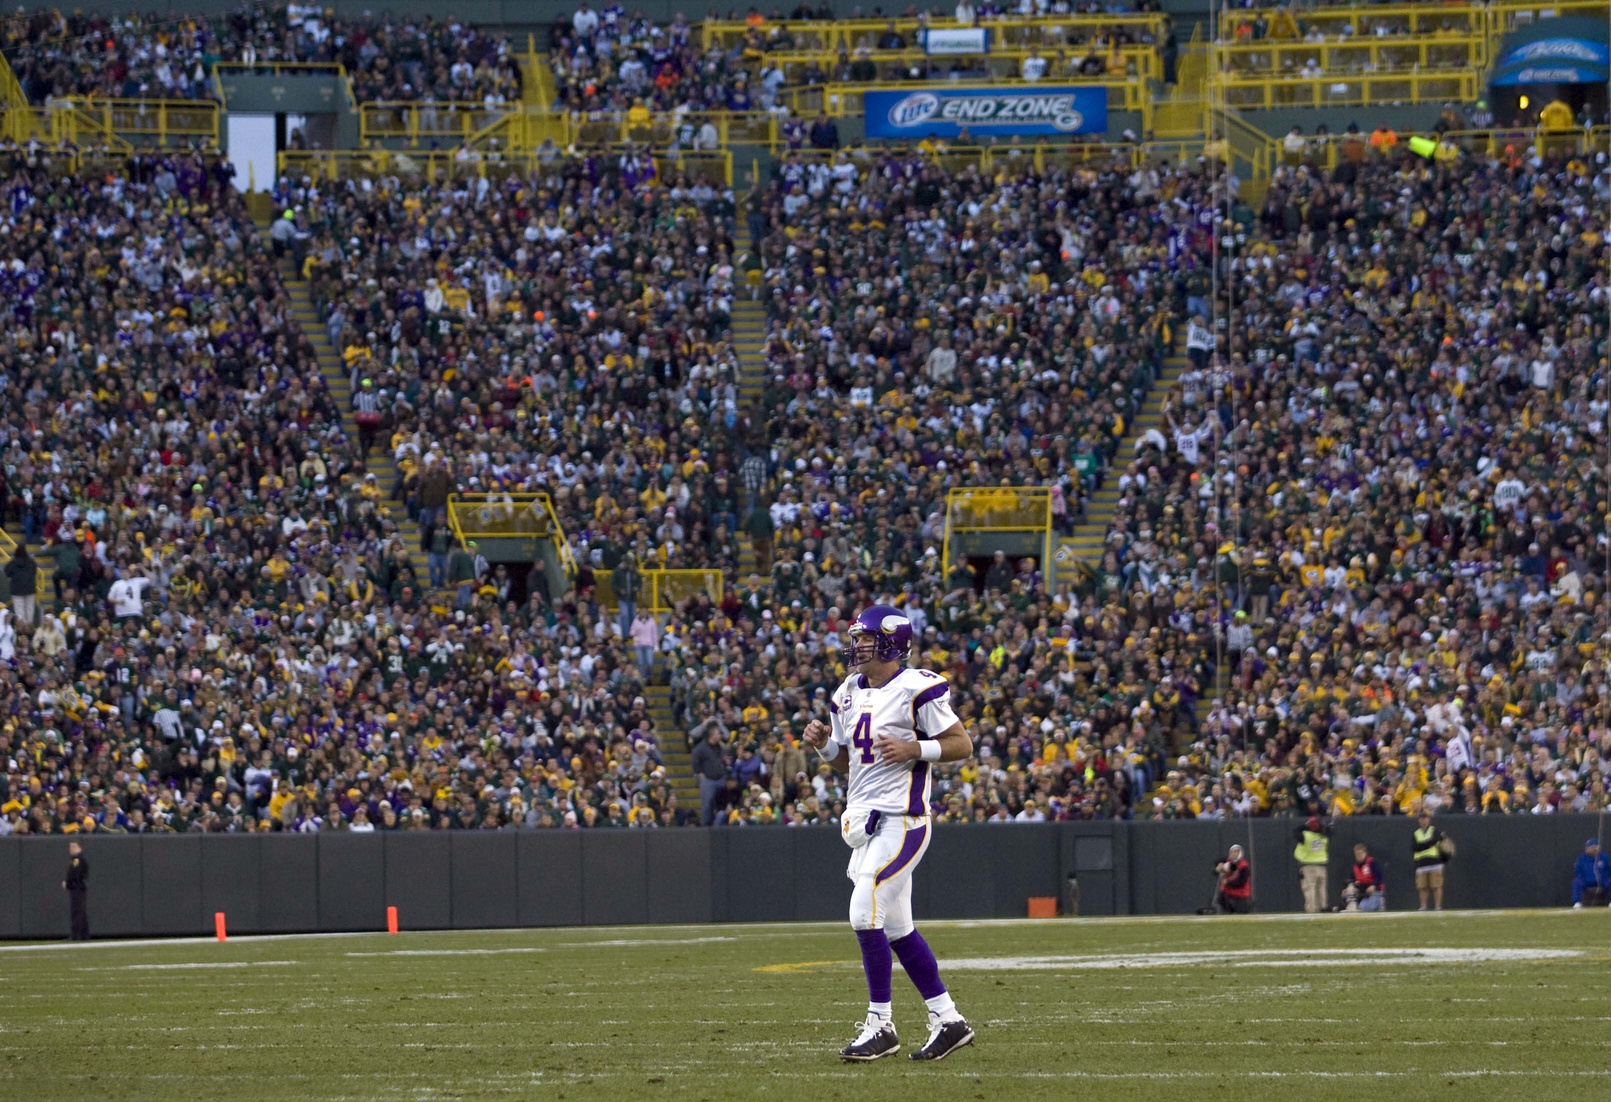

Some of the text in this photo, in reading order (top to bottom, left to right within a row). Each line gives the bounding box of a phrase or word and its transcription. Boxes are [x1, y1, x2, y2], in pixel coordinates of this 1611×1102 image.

[901, 101, 934, 122] Lite
[942, 98, 996, 117] END
[996, 96, 1069, 116] ZONE
[852, 711, 876, 765] 4
